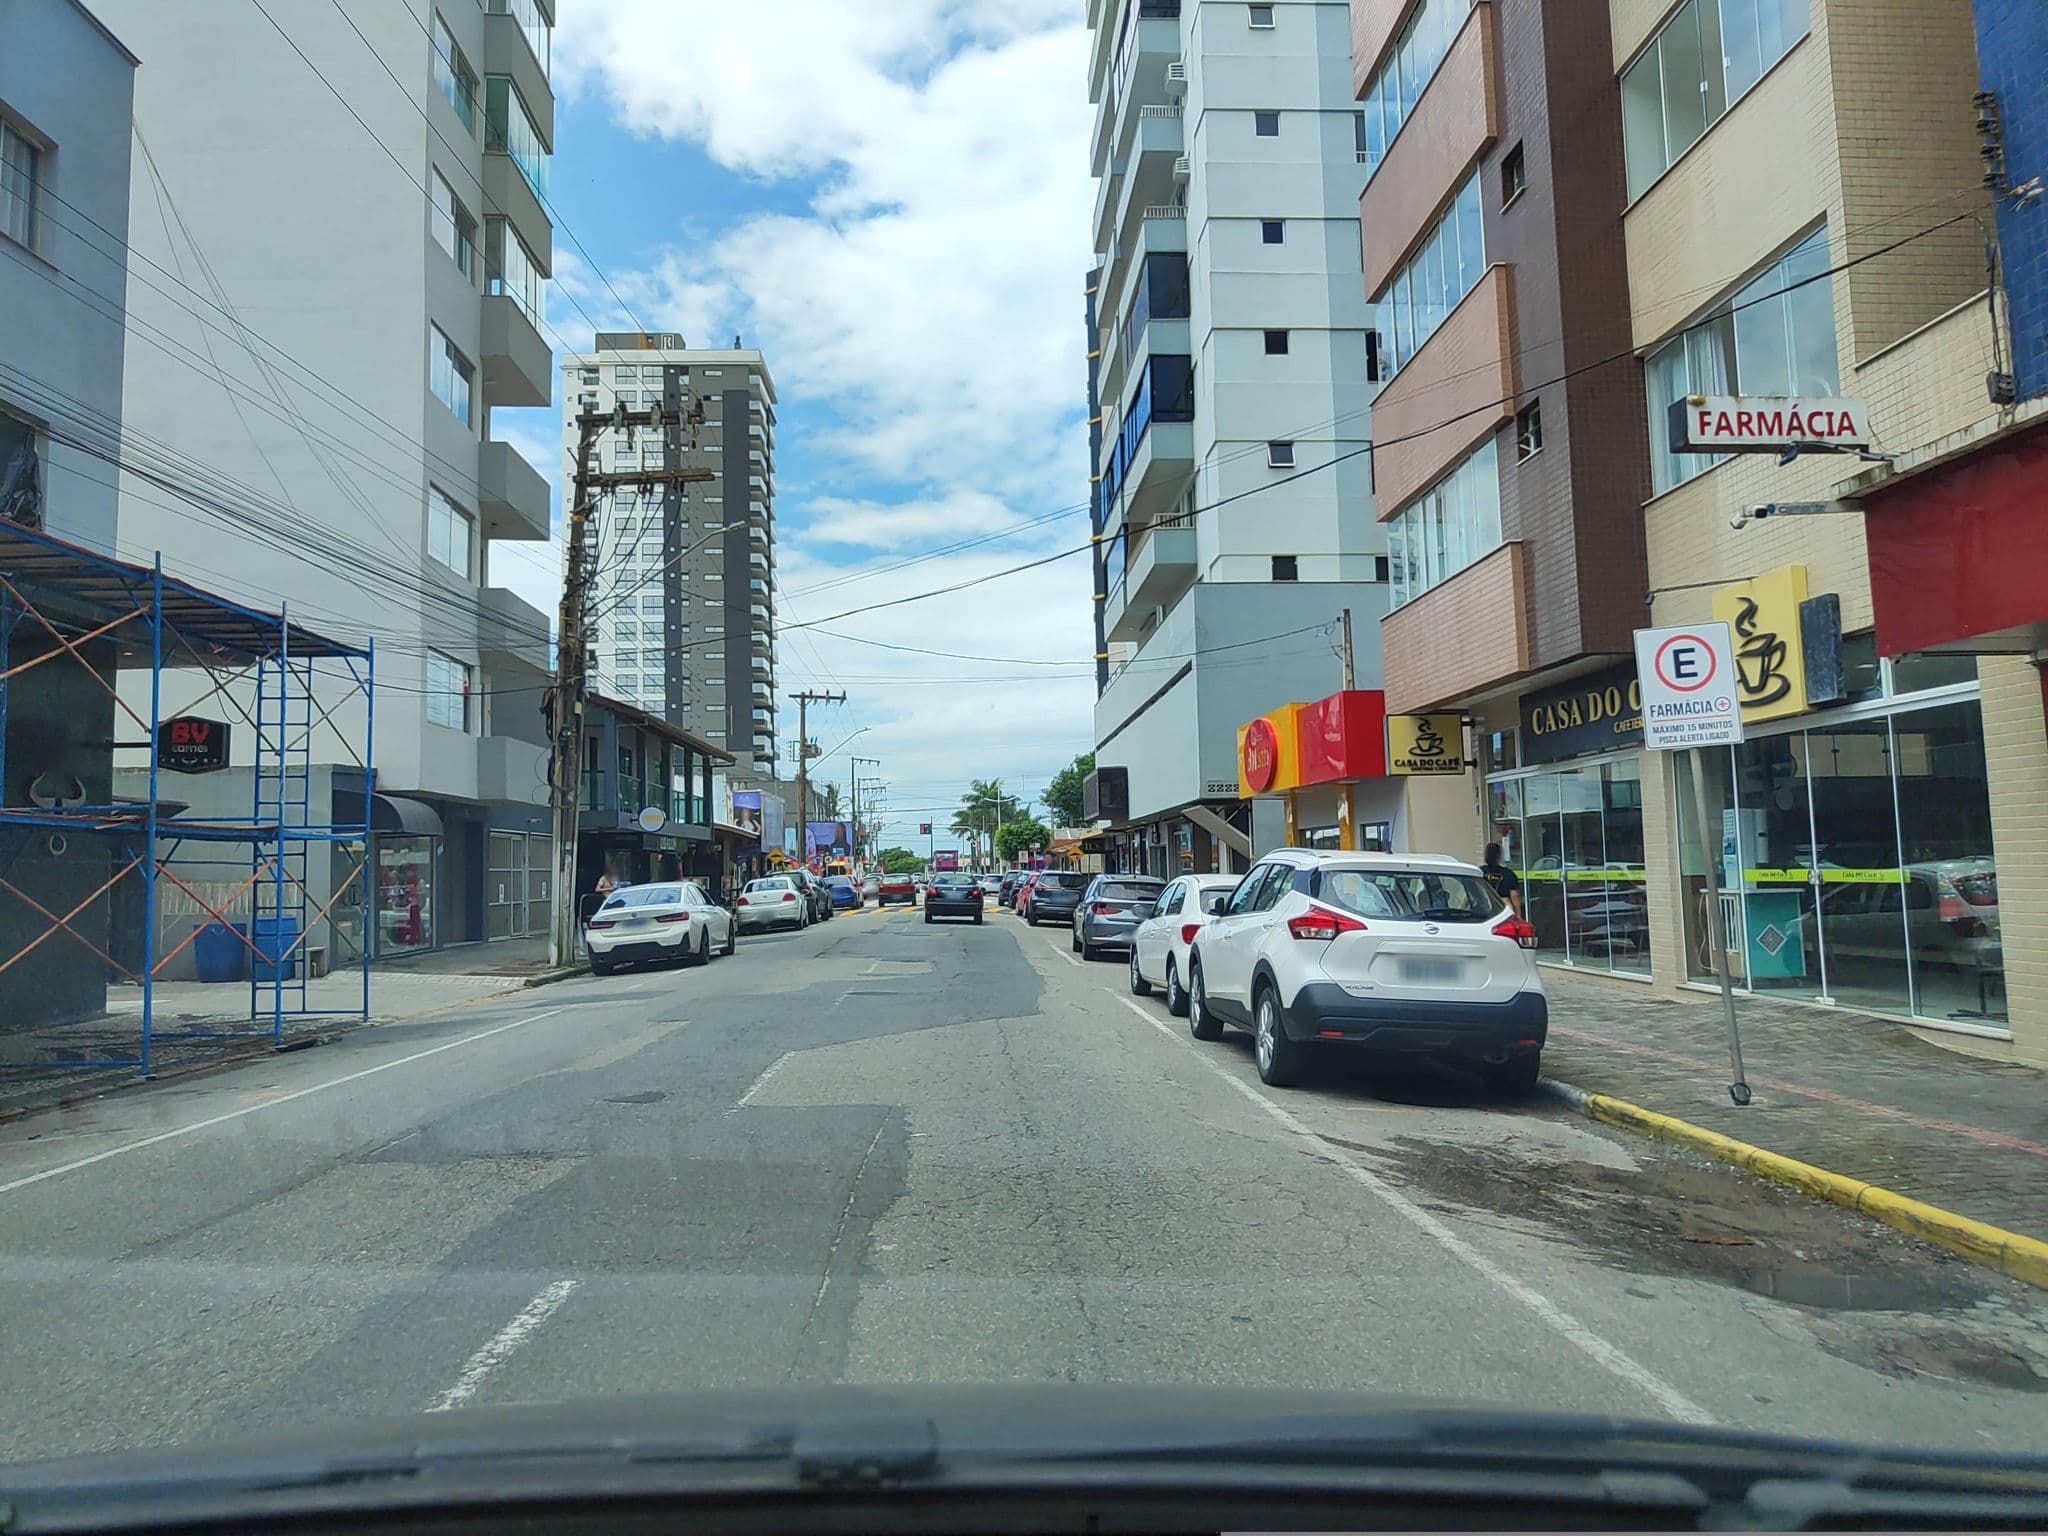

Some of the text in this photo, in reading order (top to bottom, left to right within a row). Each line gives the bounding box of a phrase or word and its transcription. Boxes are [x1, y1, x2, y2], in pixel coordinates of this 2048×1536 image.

[1698, 403, 1857, 437] FARMÁCIA
[1672, 647, 1698, 679] E
[1531, 698, 1583, 735] CASA
[1587, 686, 1621, 722] DO
[1650, 699, 1713, 718] FARMÁCIA
[171, 721, 210, 744] BV
[1687, 723, 1697, 732] 15
[1698, 720, 1733, 731] MINUTOS
[1659, 731, 1729, 744] PISCA ALERTA LIGADO
[1394, 759, 1418, 767] CASA
[1420, 759, 1434, 767] DO
